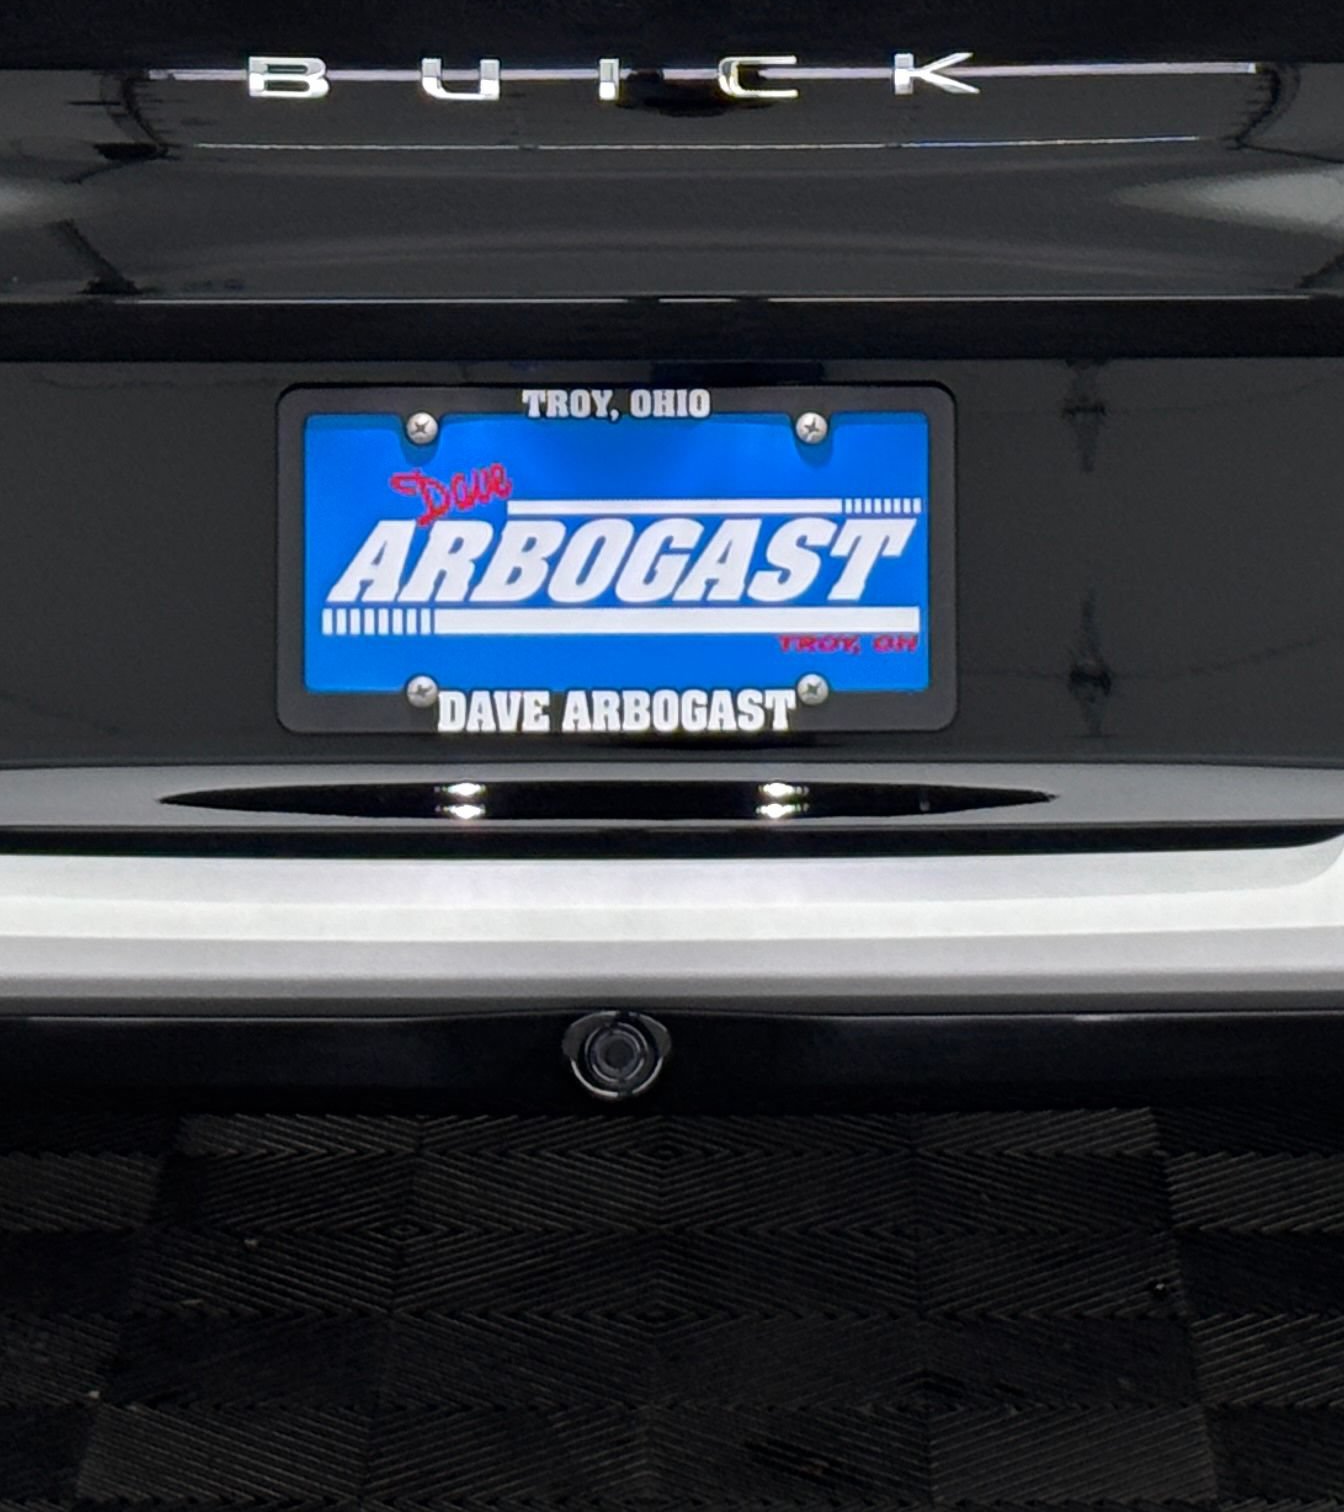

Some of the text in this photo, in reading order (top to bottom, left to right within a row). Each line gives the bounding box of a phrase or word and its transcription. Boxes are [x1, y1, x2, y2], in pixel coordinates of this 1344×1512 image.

[248, 51, 980, 100] BUICK
[522, 389, 711, 421] TROY, OHIO
[389, 462, 513, 527] Dave
[326, 517, 917, 603] ARBOGAST
[872, 634, 918, 653] OH
[437, 689, 797, 732] DAVE ARBOGAST
